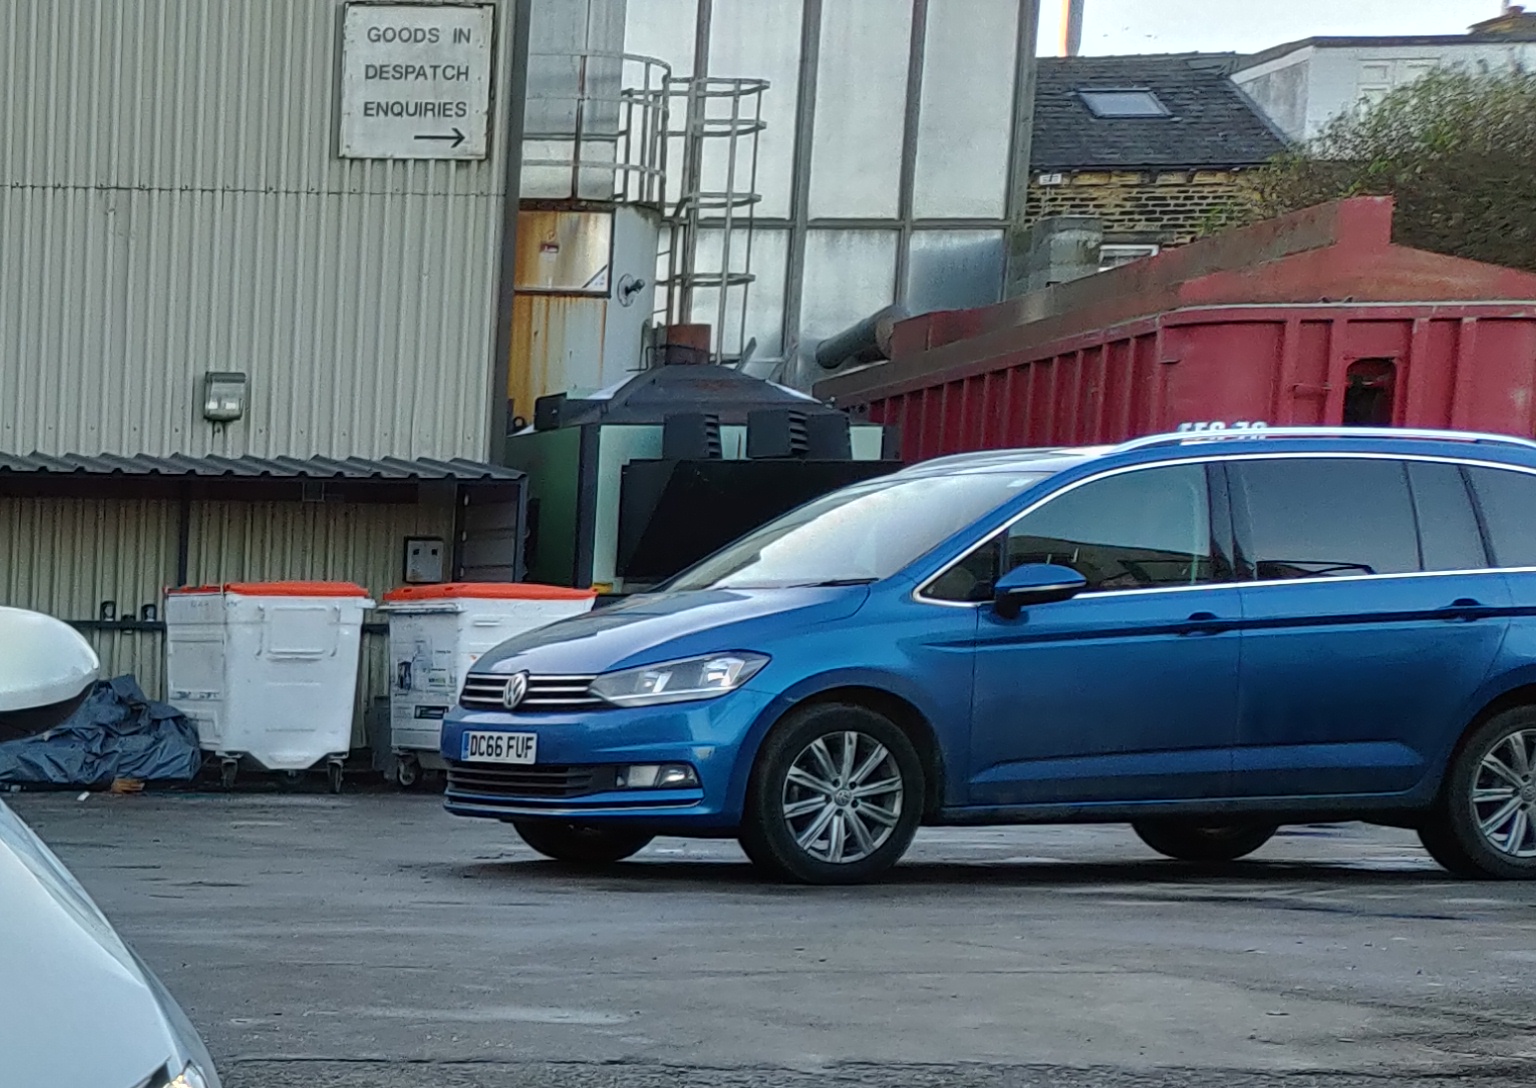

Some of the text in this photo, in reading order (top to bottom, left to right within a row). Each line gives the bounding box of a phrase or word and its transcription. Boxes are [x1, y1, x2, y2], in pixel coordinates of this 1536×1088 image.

[366, 27, 471, 44] GOODS IN
[364, 64, 469, 82] DESPATCH
[363, 101, 467, 119] ENQUIRIES
[470, 734, 534, 758] DC66 FUF
